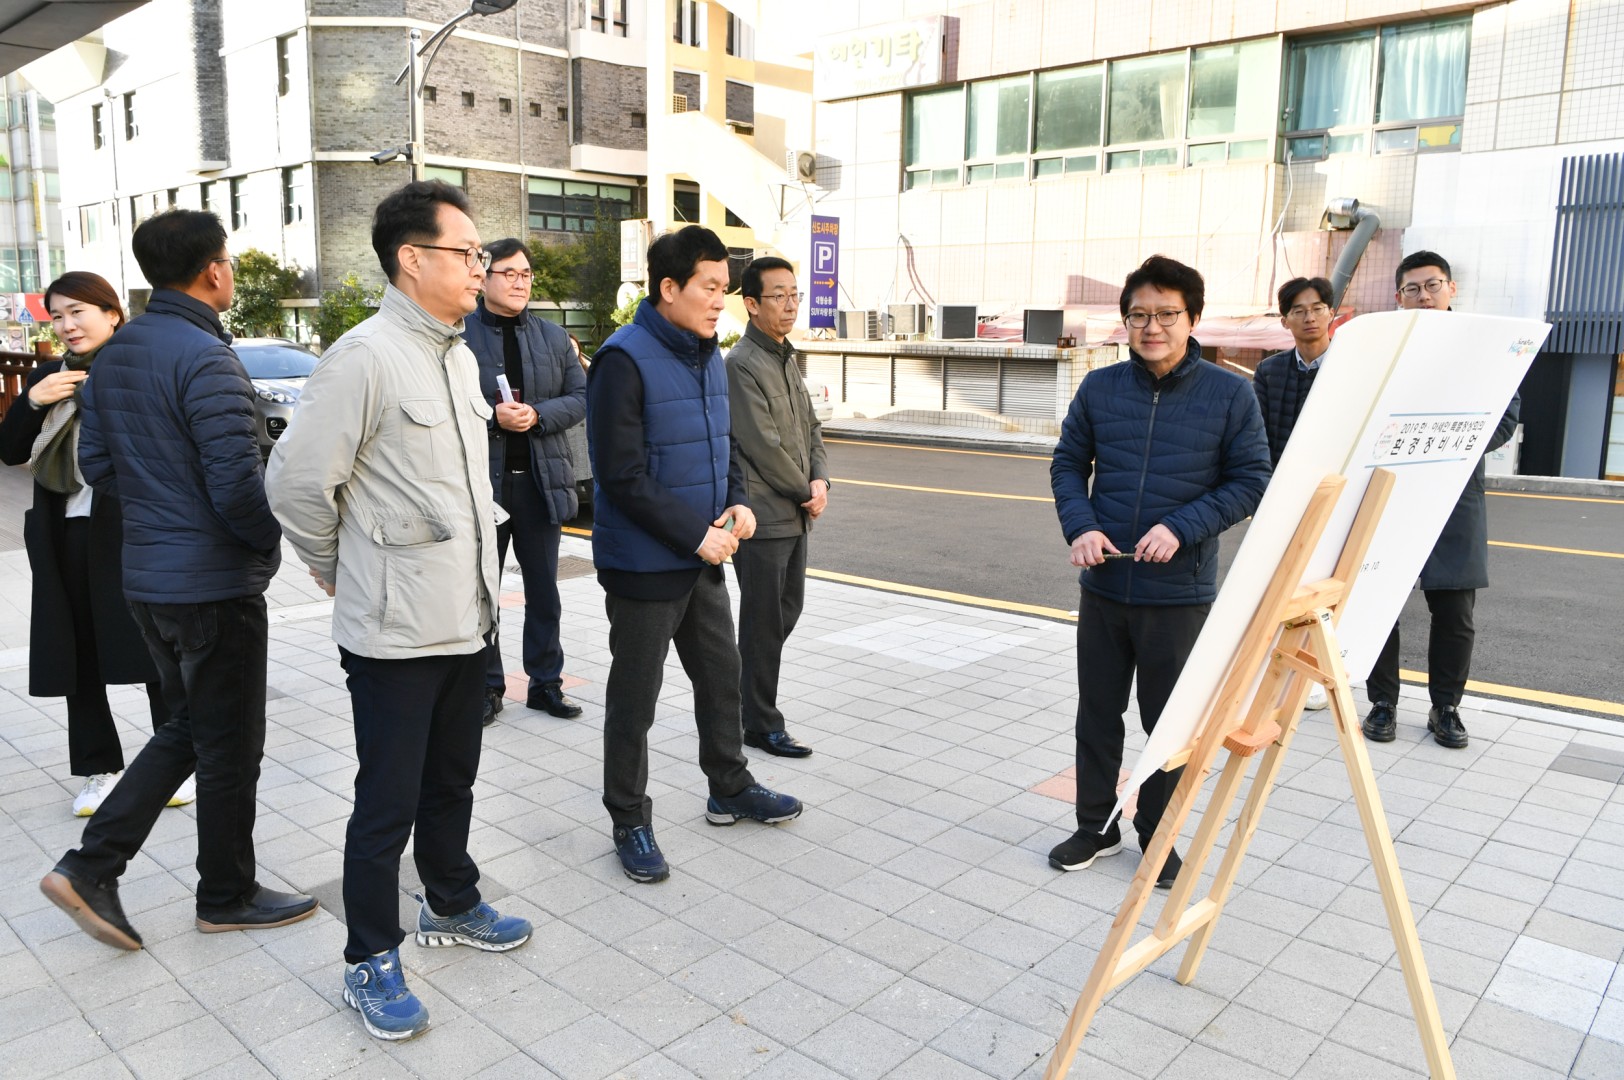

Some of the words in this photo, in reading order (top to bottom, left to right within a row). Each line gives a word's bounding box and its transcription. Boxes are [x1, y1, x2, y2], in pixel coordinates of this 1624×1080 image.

[812, 221, 839, 236] 신도시주차장
[818, 246, 832, 269] P
[1400, 422, 1420, 434] 2019
